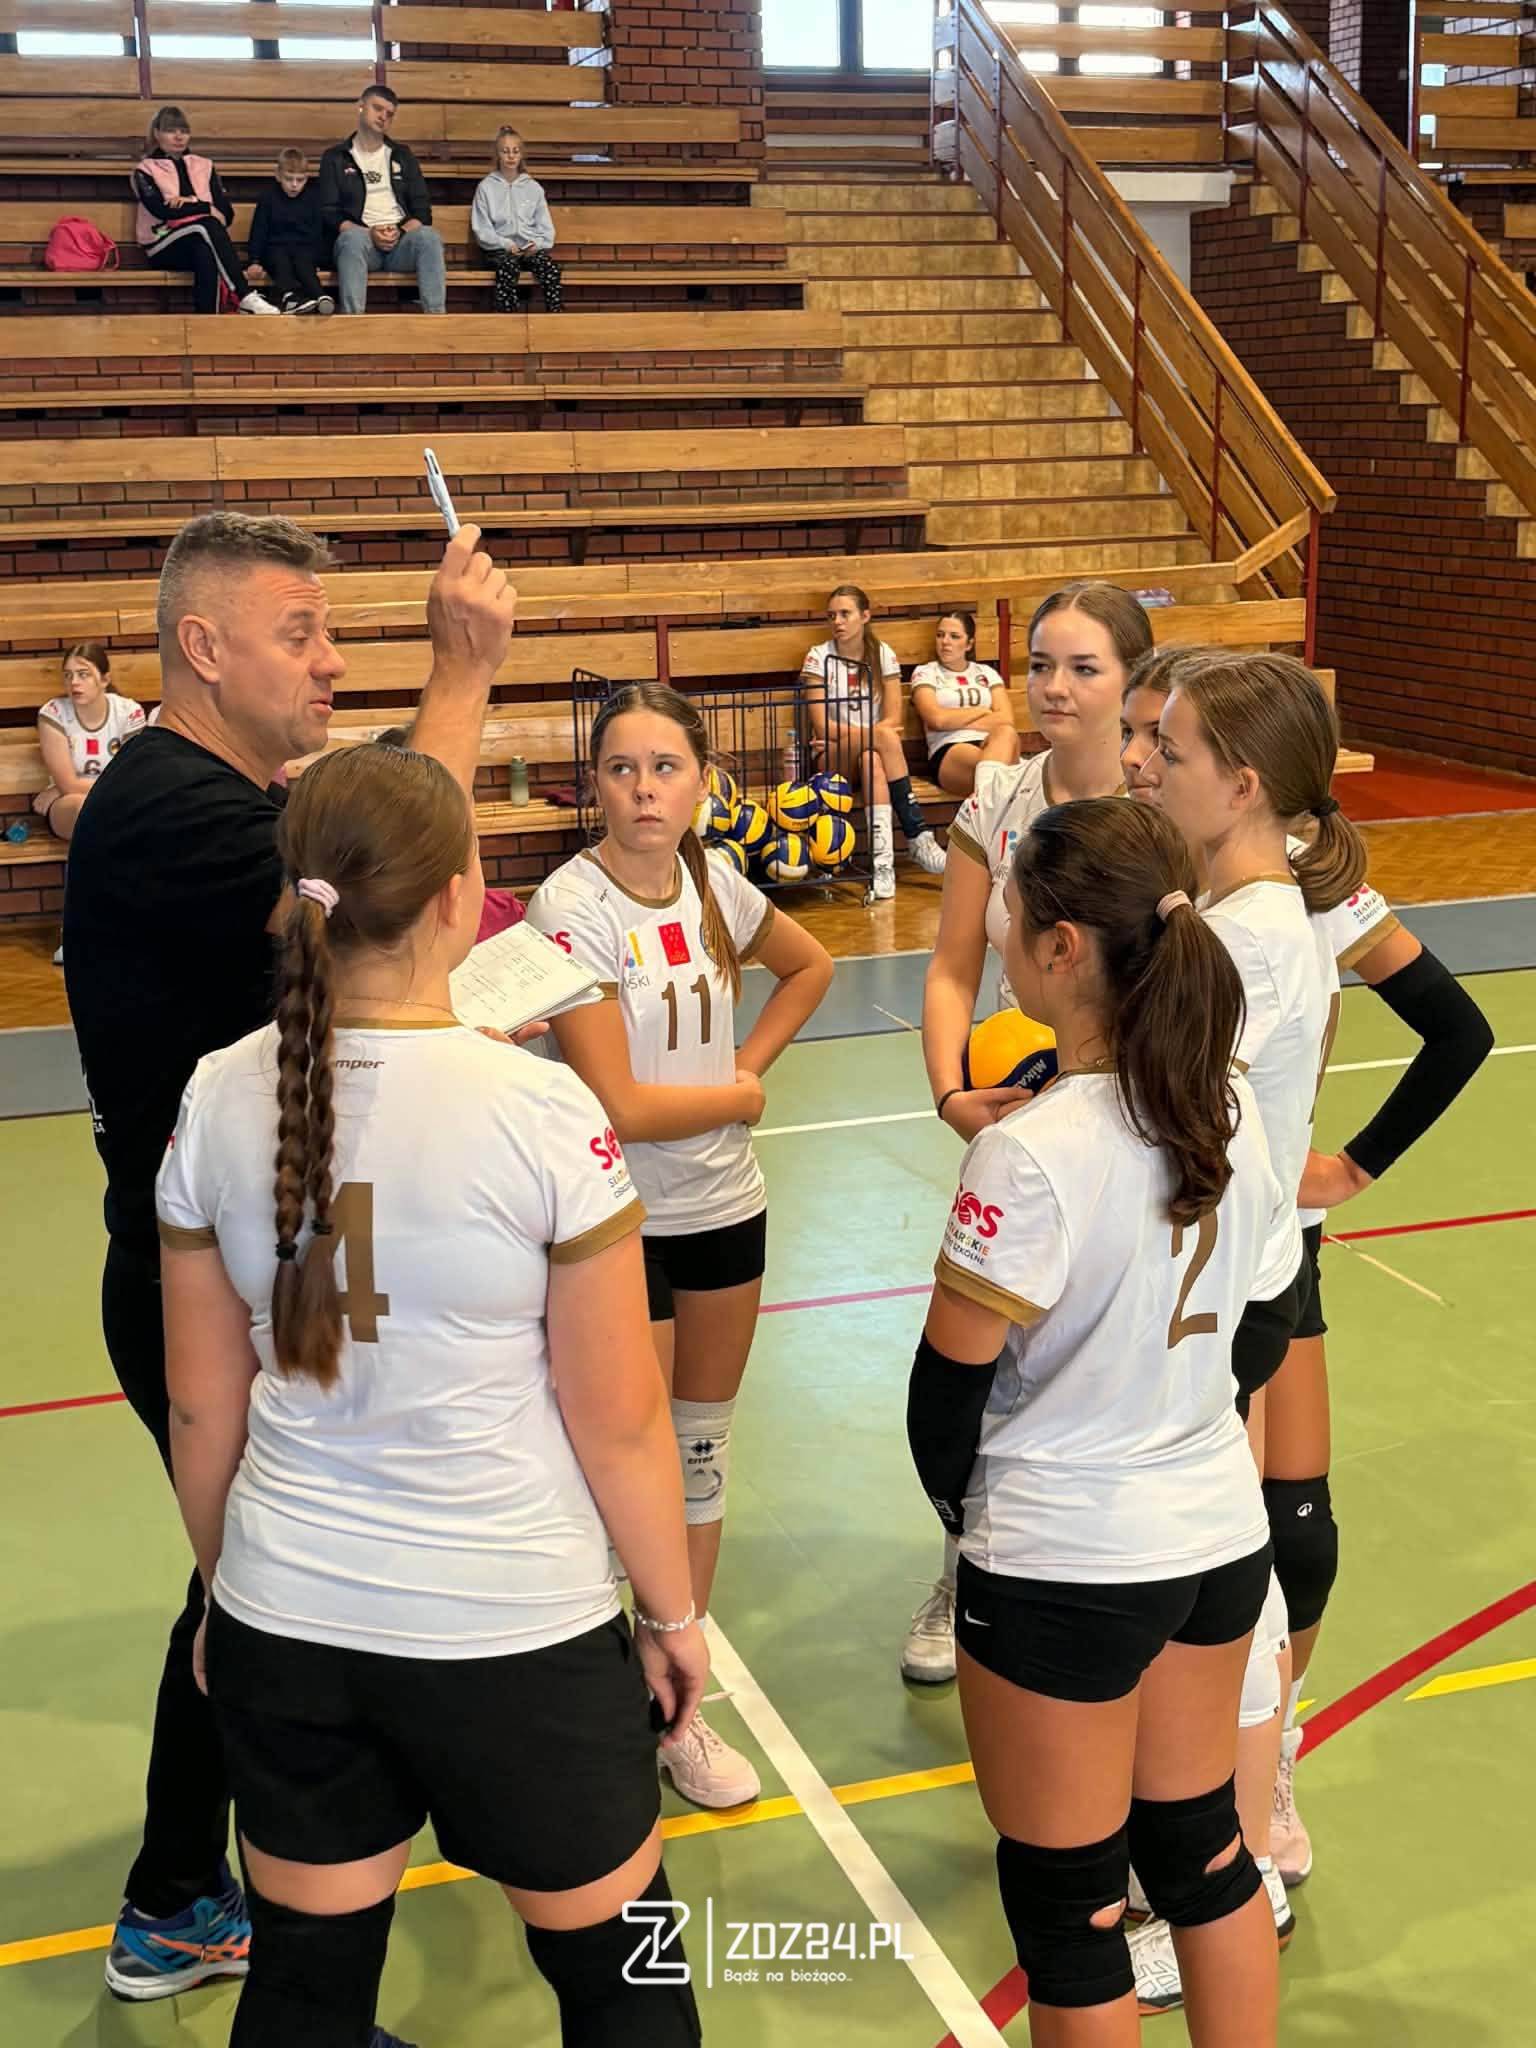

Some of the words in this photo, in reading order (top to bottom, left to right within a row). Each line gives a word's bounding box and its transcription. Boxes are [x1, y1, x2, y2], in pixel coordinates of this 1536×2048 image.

[956, 688, 981, 707] 10
[661, 974, 711, 1051] 11
[335, 1182, 390, 1343] 4
[1167, 1209, 1218, 1349] 2
